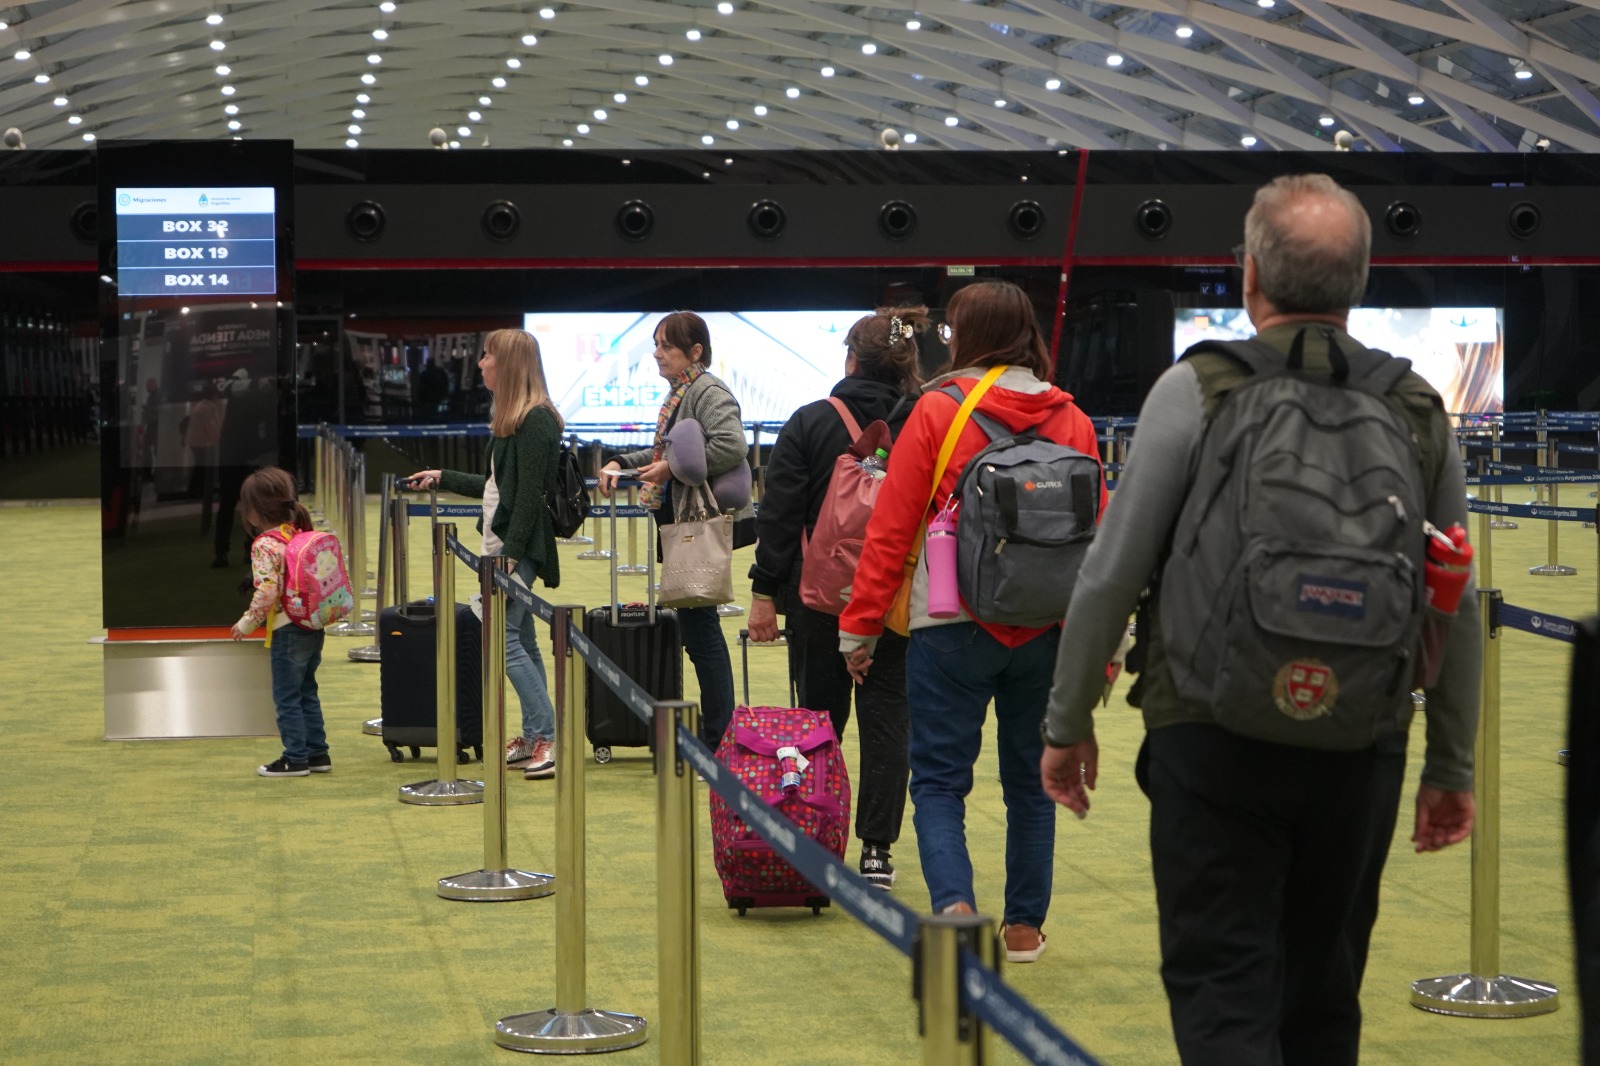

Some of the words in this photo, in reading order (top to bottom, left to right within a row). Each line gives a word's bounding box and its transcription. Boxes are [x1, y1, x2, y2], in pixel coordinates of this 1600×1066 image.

[162, 220, 203, 233] BOX
[207, 220, 229, 232] 32
[164, 247, 205, 260] BOX
[208, 246, 229, 260] 19
[164, 274, 205, 287] BOX
[208, 273, 230, 286] 14
[583, 386, 670, 406] EMPIEZ
[608, 507, 643, 516] ropuertos
[864, 859, 883, 869] DKNY
